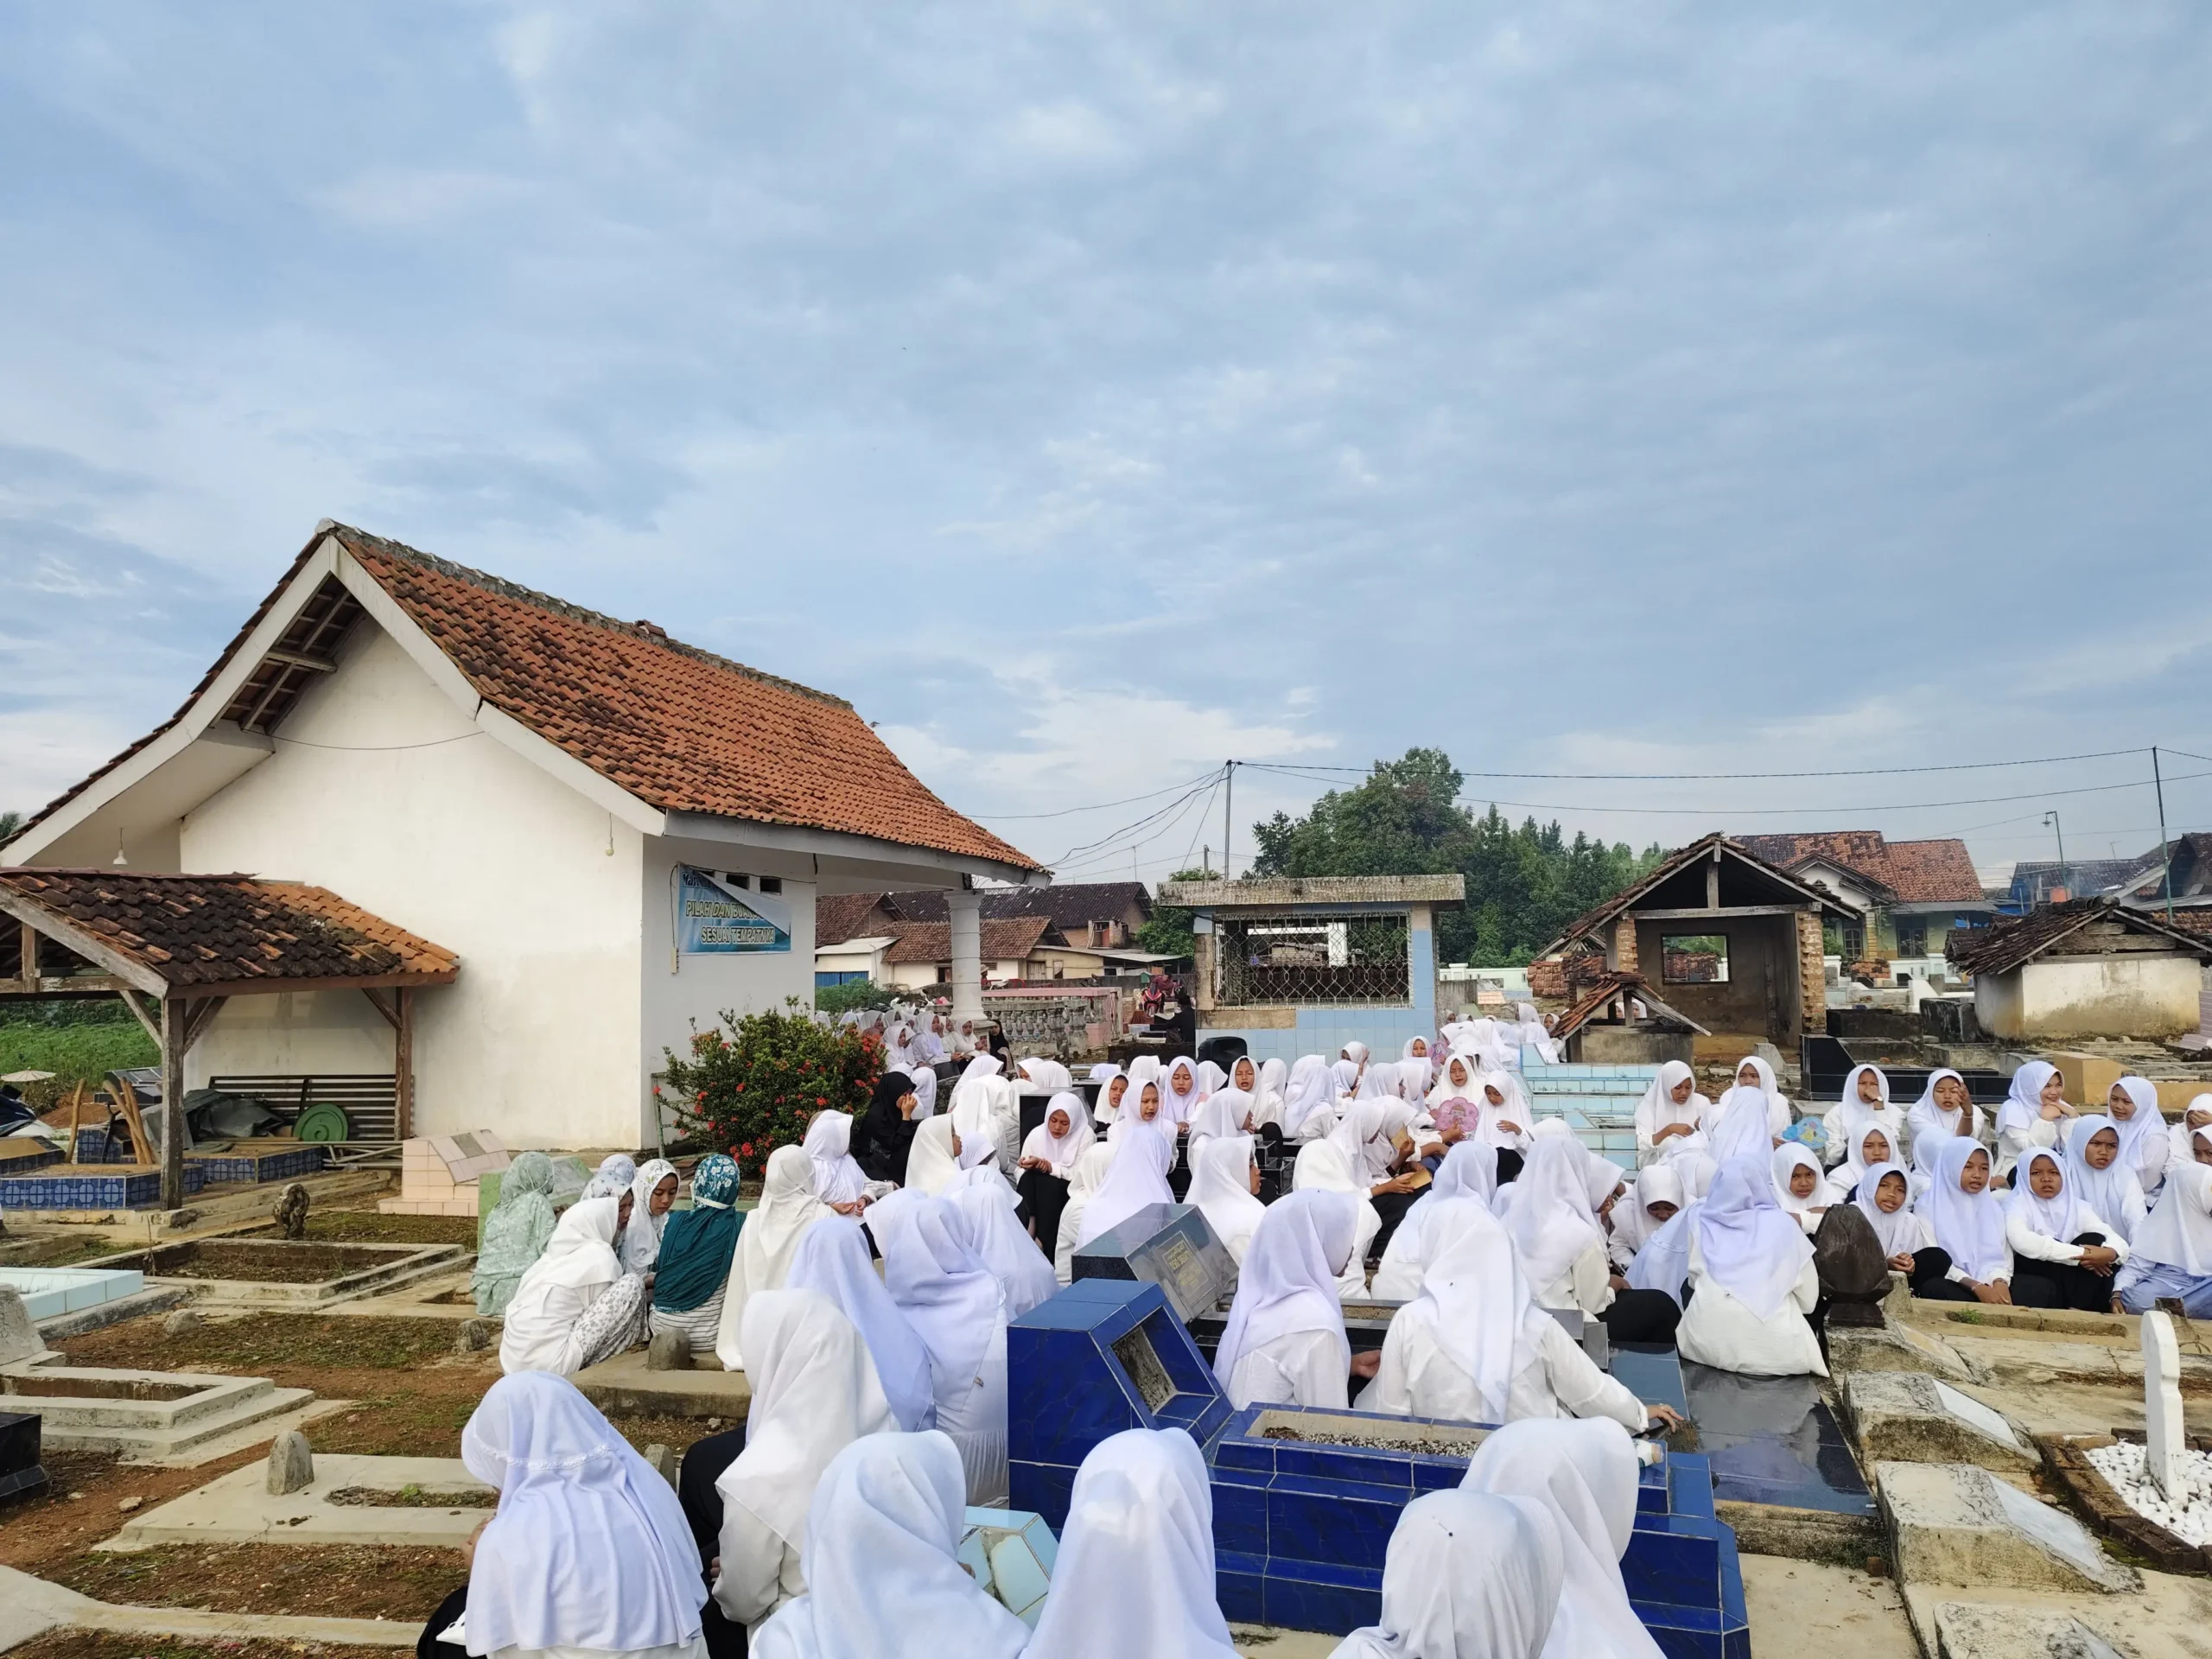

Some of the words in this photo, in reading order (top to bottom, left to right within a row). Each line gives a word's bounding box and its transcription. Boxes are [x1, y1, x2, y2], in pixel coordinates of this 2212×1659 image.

[686, 900, 711, 918] PILAH
[712, 902, 731, 918] DAN
[701, 926, 730, 944] SESUAI
[730, 927, 775, 944] TEMPATNYA
